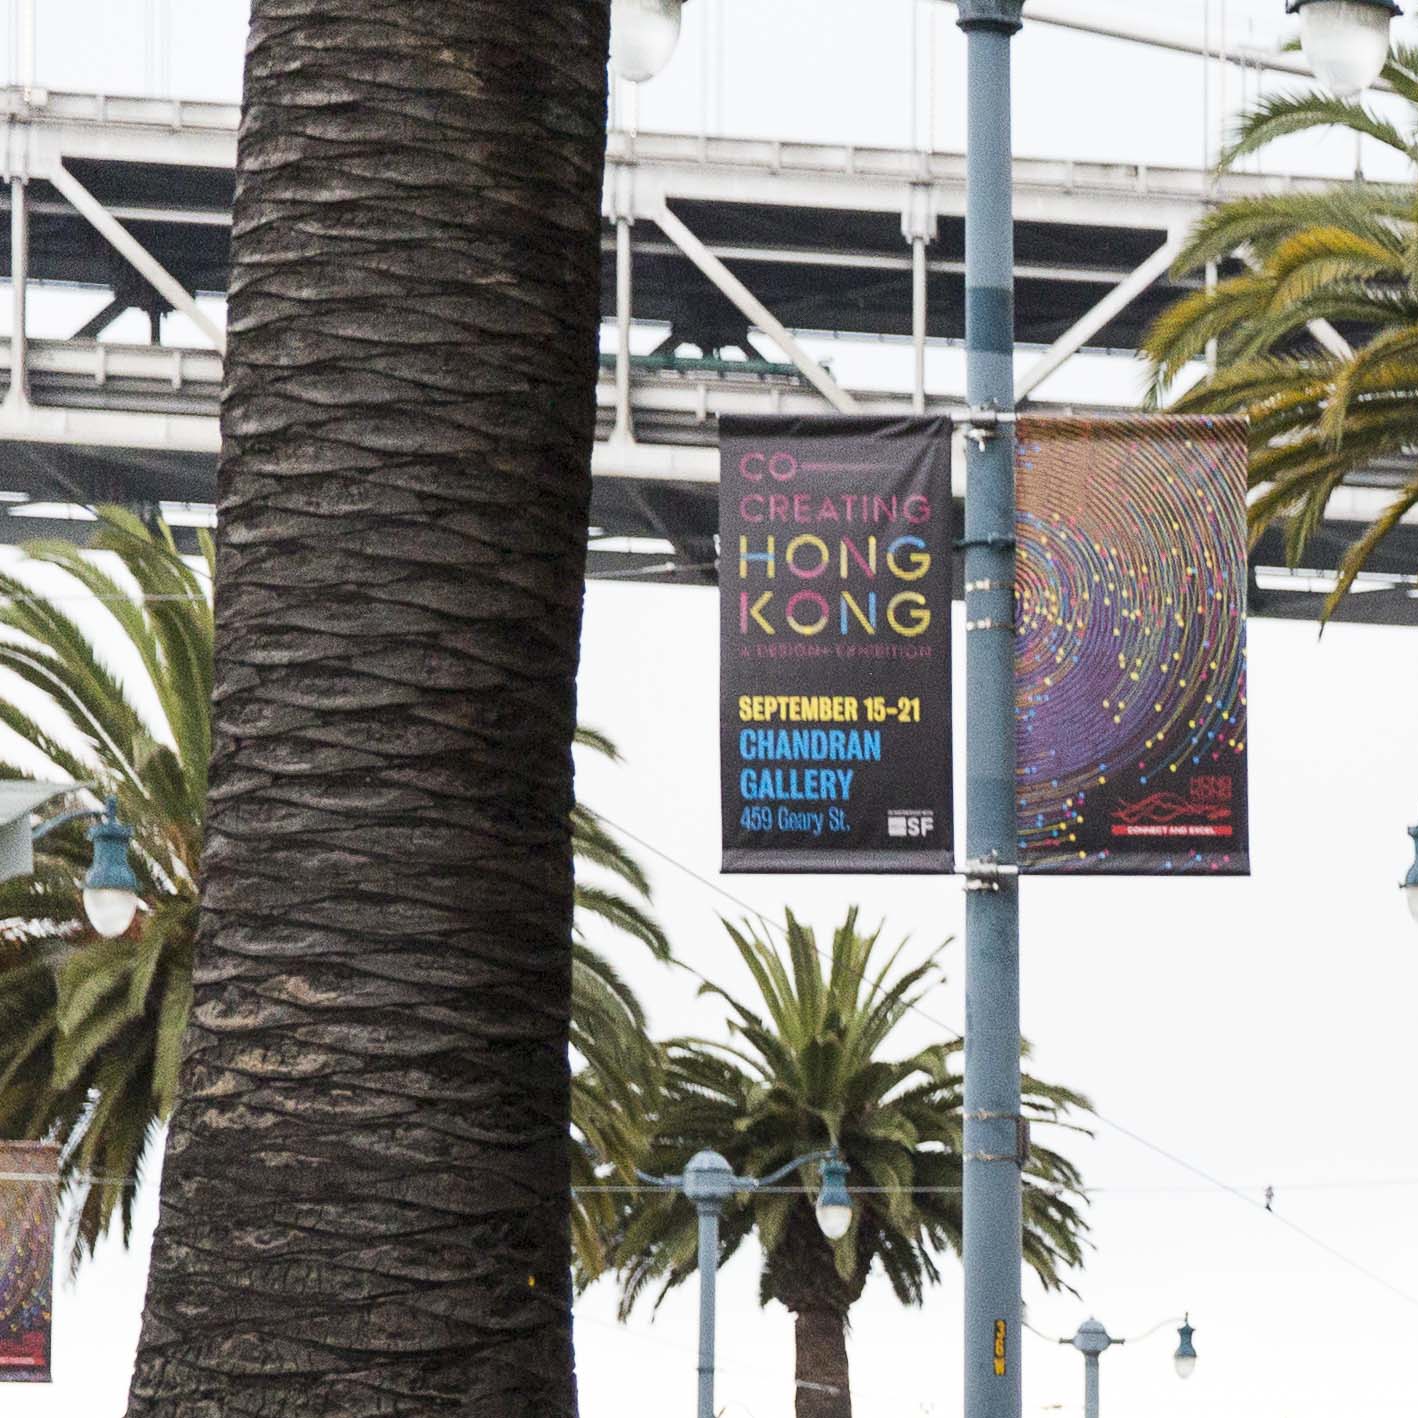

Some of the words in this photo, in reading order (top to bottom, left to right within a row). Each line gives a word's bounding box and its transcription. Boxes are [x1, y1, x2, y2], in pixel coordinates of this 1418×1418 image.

[739, 493, 932, 524] CREATING
[739, 533, 932, 581] HONG
[739, 589, 932, 638] KONG
[739, 695, 858, 722] SEPTEMBER
[863, 696, 921, 722] 15-21
[739, 728, 881, 761] CHANDRAN
[739, 768, 854, 800] GALLERY
[740, 806, 774, 832] 459
[778, 806, 825, 837] Geary
[907, 816, 935, 838] SF
